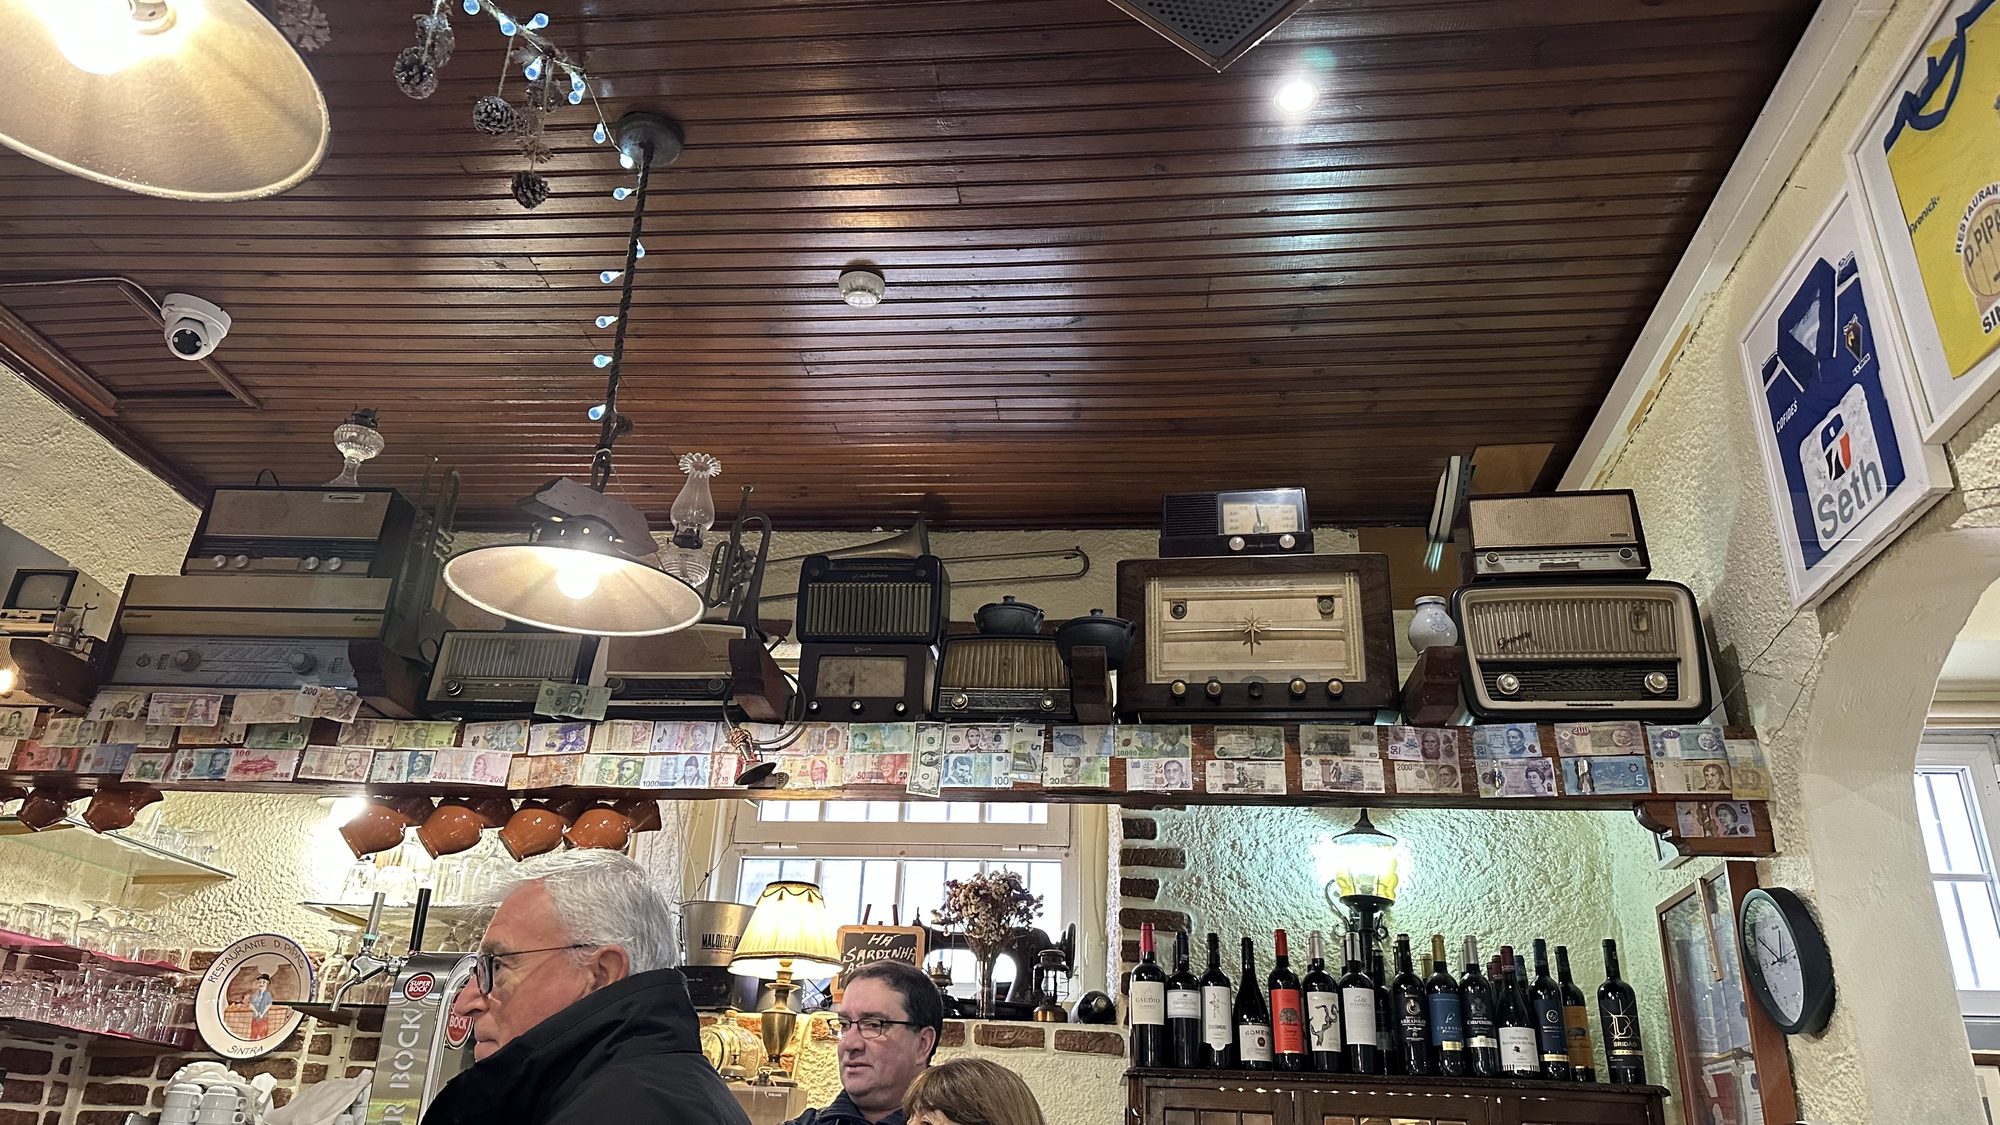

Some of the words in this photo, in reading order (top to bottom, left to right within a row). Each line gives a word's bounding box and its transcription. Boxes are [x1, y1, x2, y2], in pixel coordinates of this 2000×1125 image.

[1817, 458, 1882, 539] Seth
[302, 686, 318, 696] 200
[1390, 745, 1398, 754] 50
[1476, 746, 1484, 755] 20
[433, 772, 447, 780] 200
[856, 771, 866, 780] 50
[899, 772, 907, 780] 50
[993, 776, 1009, 785] 100
[1634, 774, 1645, 786] 5
[1740, 803, 1748, 814] 5
[208, 939, 267, 984] RESTAURANTE
[273, 939, 283, 950] D.
[284, 944, 304, 969] PIPAS
[408, 985, 428, 993] BOCK
[449, 1015, 468, 1030] BOCK
[227, 1045, 264, 1055] SINTRA
[389, 1009, 425, 1089] BOCK
